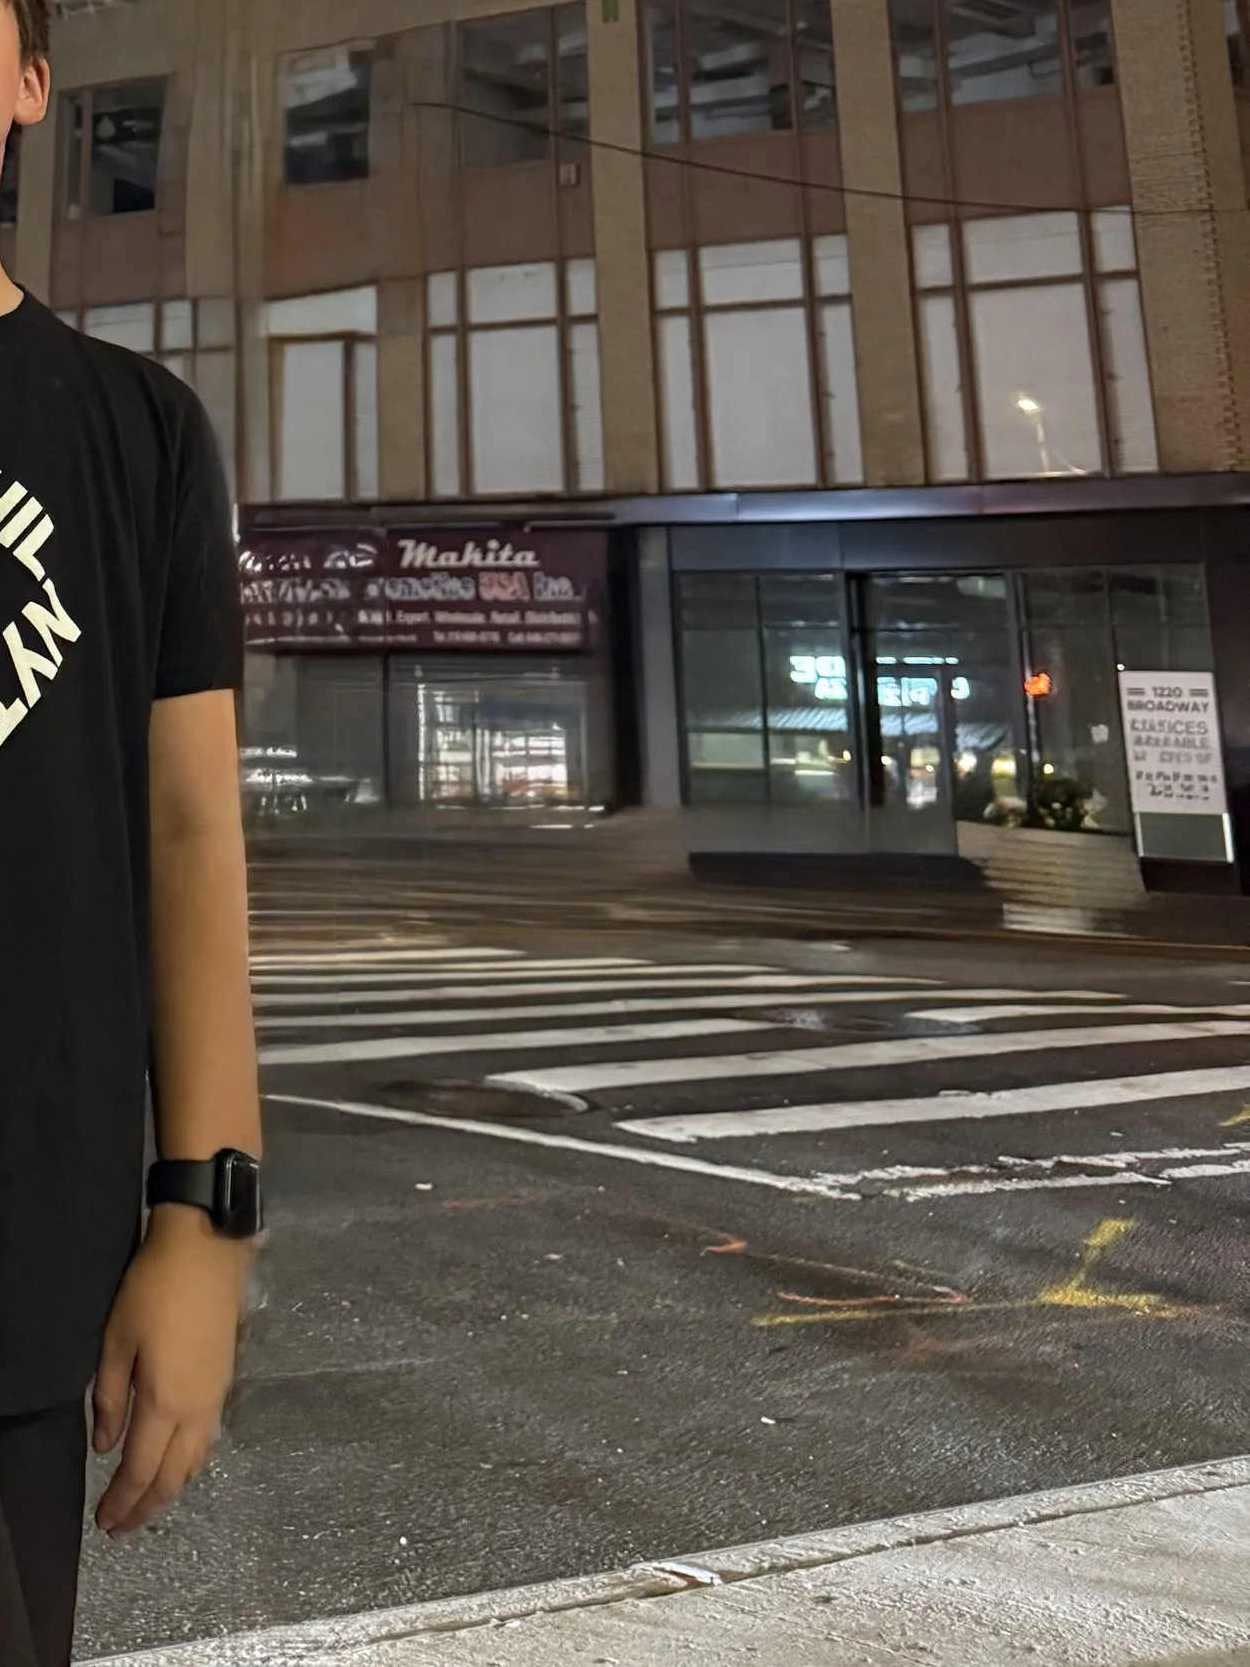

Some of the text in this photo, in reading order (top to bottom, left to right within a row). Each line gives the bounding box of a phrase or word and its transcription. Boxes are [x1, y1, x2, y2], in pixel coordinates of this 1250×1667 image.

[397, 538, 540, 569] Makita
[1151, 686, 1183, 698] 1220
[1127, 699, 1210, 713] BROADWAY
